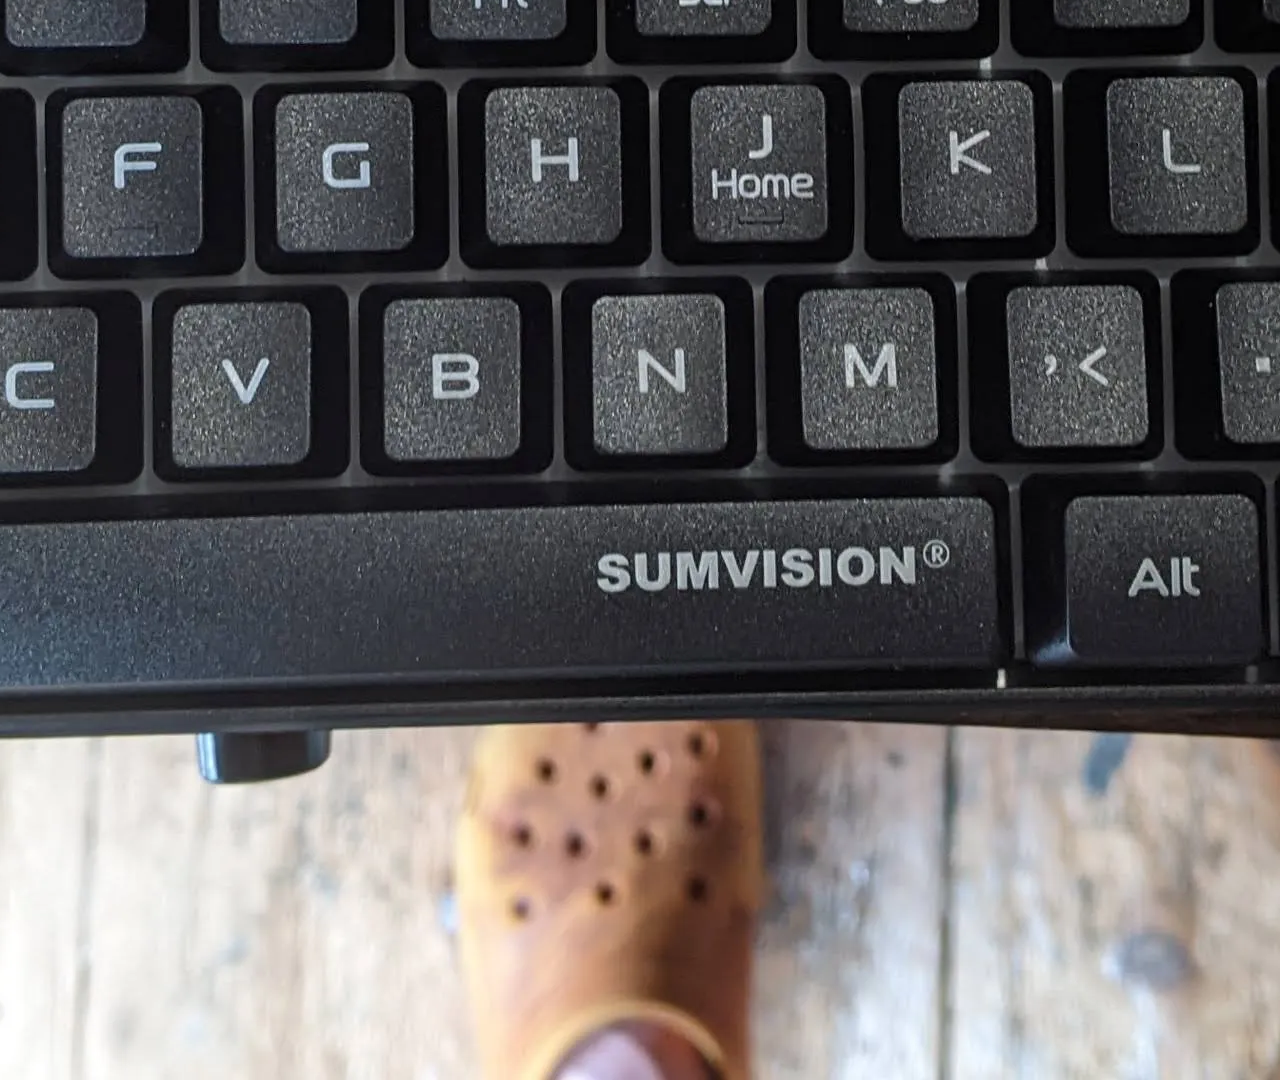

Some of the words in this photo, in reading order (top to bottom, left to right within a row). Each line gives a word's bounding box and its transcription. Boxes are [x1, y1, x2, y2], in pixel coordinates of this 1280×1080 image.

[748, 114, 773, 159] J
[949, 130, 992, 175] K
[1162, 128, 1201, 173] L
[113, 142, 162, 190] F
[321, 142, 371, 189] G
[530, 137, 579, 183] H
[711, 168, 814, 200] Home
[4, 361, 55, 409] C
[221, 357, 270, 404] V
[432, 353, 480, 399] B
[637, 348, 686, 394] N
[843, 343, 897, 388] M
[1128, 556, 1201, 597] Alt
